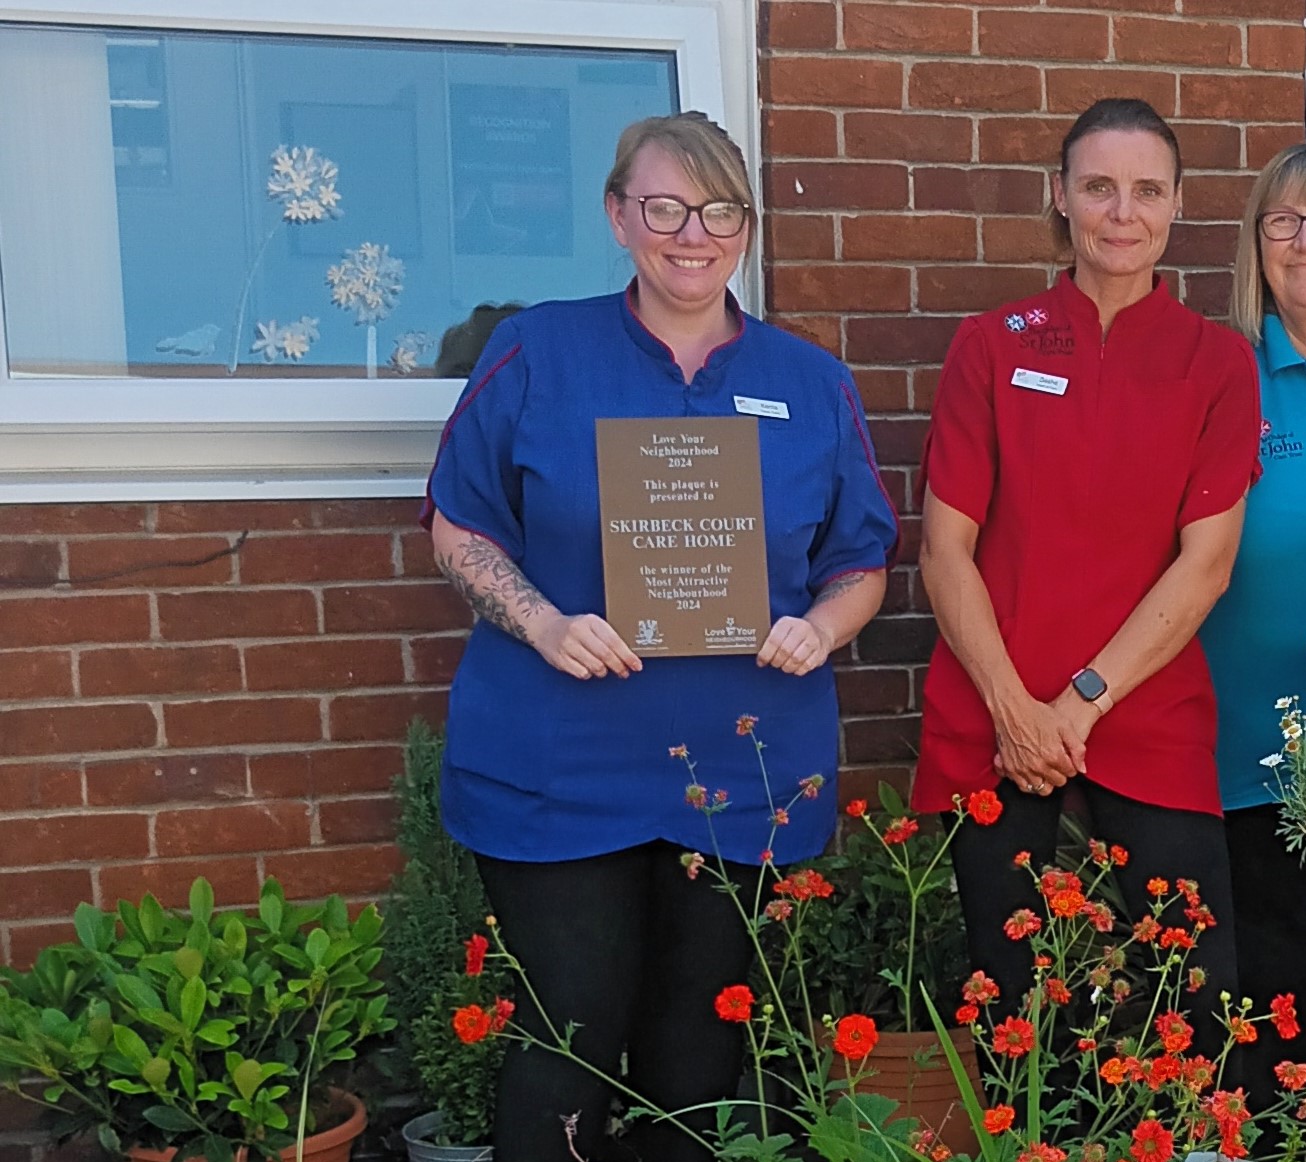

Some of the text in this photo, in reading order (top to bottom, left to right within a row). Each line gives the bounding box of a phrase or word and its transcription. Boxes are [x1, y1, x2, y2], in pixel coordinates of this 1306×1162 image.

[1038, 332, 1075, 352] John
[652, 433, 704, 444] Love Your
[640, 445, 719, 457] Neighbourhood
[1268, 438, 1303, 459] John
[668, 457, 693, 468] 2024
[642, 478, 719, 492] This plaque is
[650, 491, 714, 504] presented to
[609, 517, 756, 533] SKIRBECK COURT
[632, 533, 736, 549] CARE HOME
[639, 563, 733, 576] the winner of the
[645, 575, 729, 587] Most Attractive
[647, 588, 728, 600] Neighbourhood
[676, 600, 701, 610] 2024
[704, 626, 757, 637] Love Your
